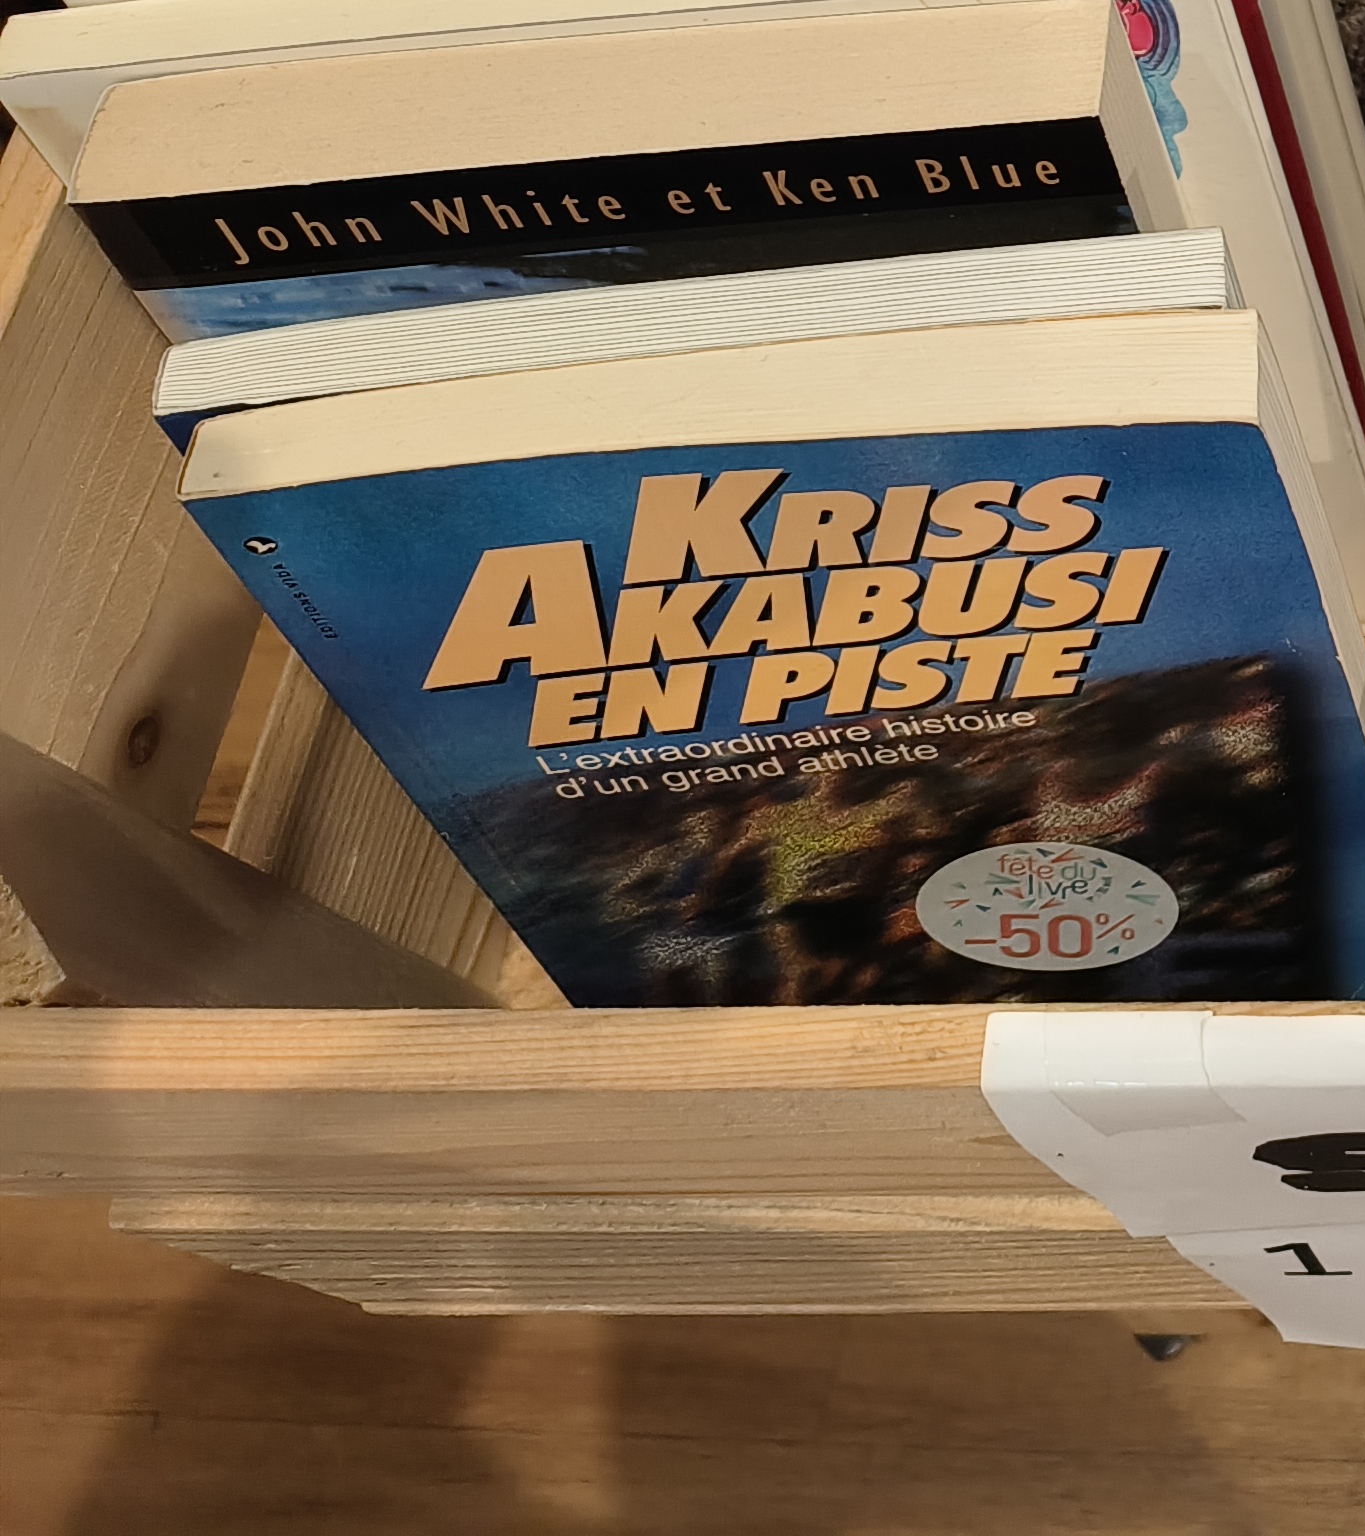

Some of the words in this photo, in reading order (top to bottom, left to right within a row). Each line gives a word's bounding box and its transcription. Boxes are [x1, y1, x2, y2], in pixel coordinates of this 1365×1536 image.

[215, 211, 382, 267] John
[411, 190, 627, 238] White
[667, 180, 731, 218] et
[762, 168, 879, 207] Ken
[914, 154, 1062, 196] Blue
[624, 468, 1109, 586] KRISS
[422, 539, 1170, 691] AKABUSI
[528, 663, 711, 749] EN
[739, 630, 1101, 724] PISTE
[535, 721, 872, 776] L'extraordinaire
[881, 708, 1036, 740] histoire
[554, 769, 650, 800] d'un
[661, 755, 786, 794] grand
[797, 740, 939, 776] athlète
[997, 853, 1054, 880] fête
[1060, 862, 1097, 881] du
[1028, 874, 1089, 899] livre
[964, 913, 1135, 958] -50%
[1259, 1240, 1354, 1280] 1
